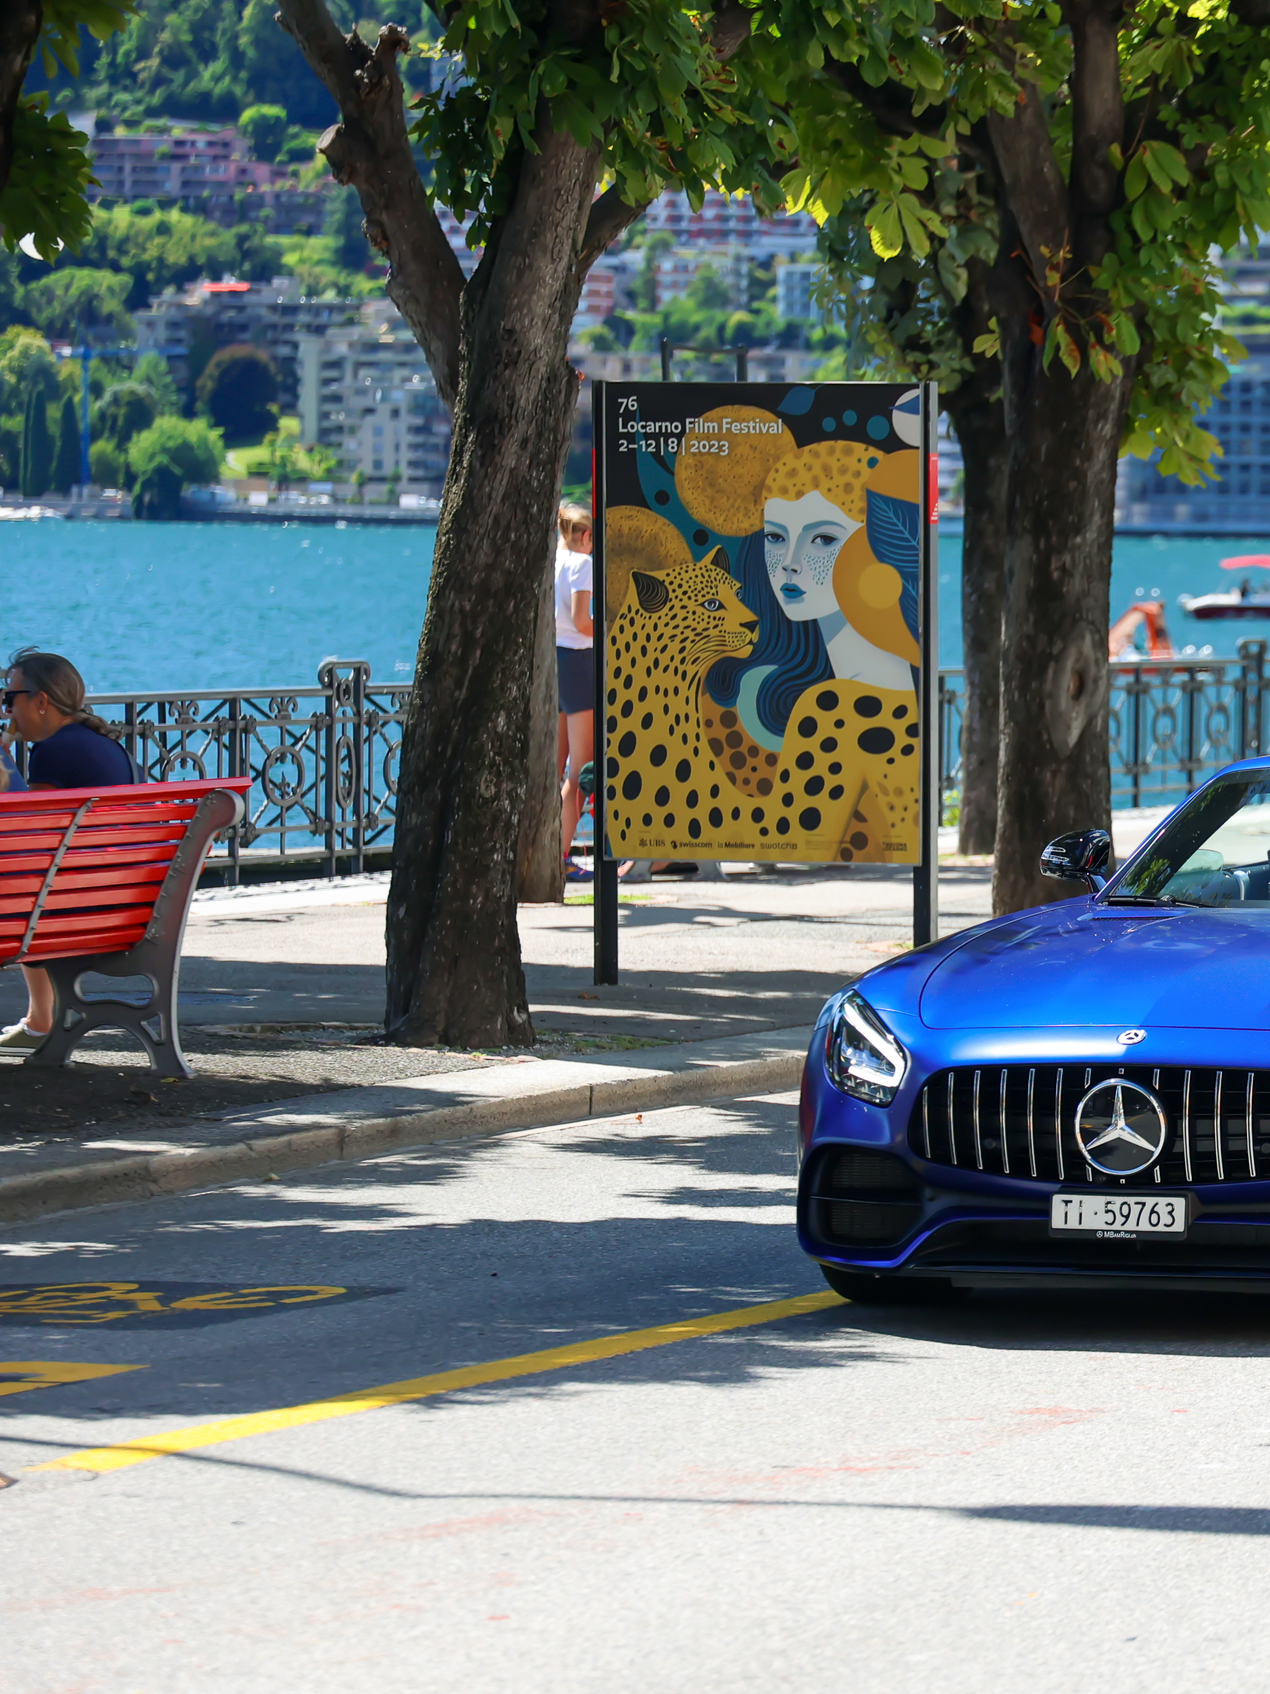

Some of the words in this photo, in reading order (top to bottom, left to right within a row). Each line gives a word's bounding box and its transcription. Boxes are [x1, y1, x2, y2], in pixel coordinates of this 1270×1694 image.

[617, 396, 638, 413] 76
[618, 417, 682, 434] Locarno
[685, 418, 719, 434] Film
[721, 418, 783, 434] Festival
[690, 440, 729, 456] 2023
[649, 839, 666, 847] UBS
[724, 841, 755, 849] Mobiliare
[1060, 1199, 1085, 1225] TI
[1104, 1201, 1176, 1228] 59763
